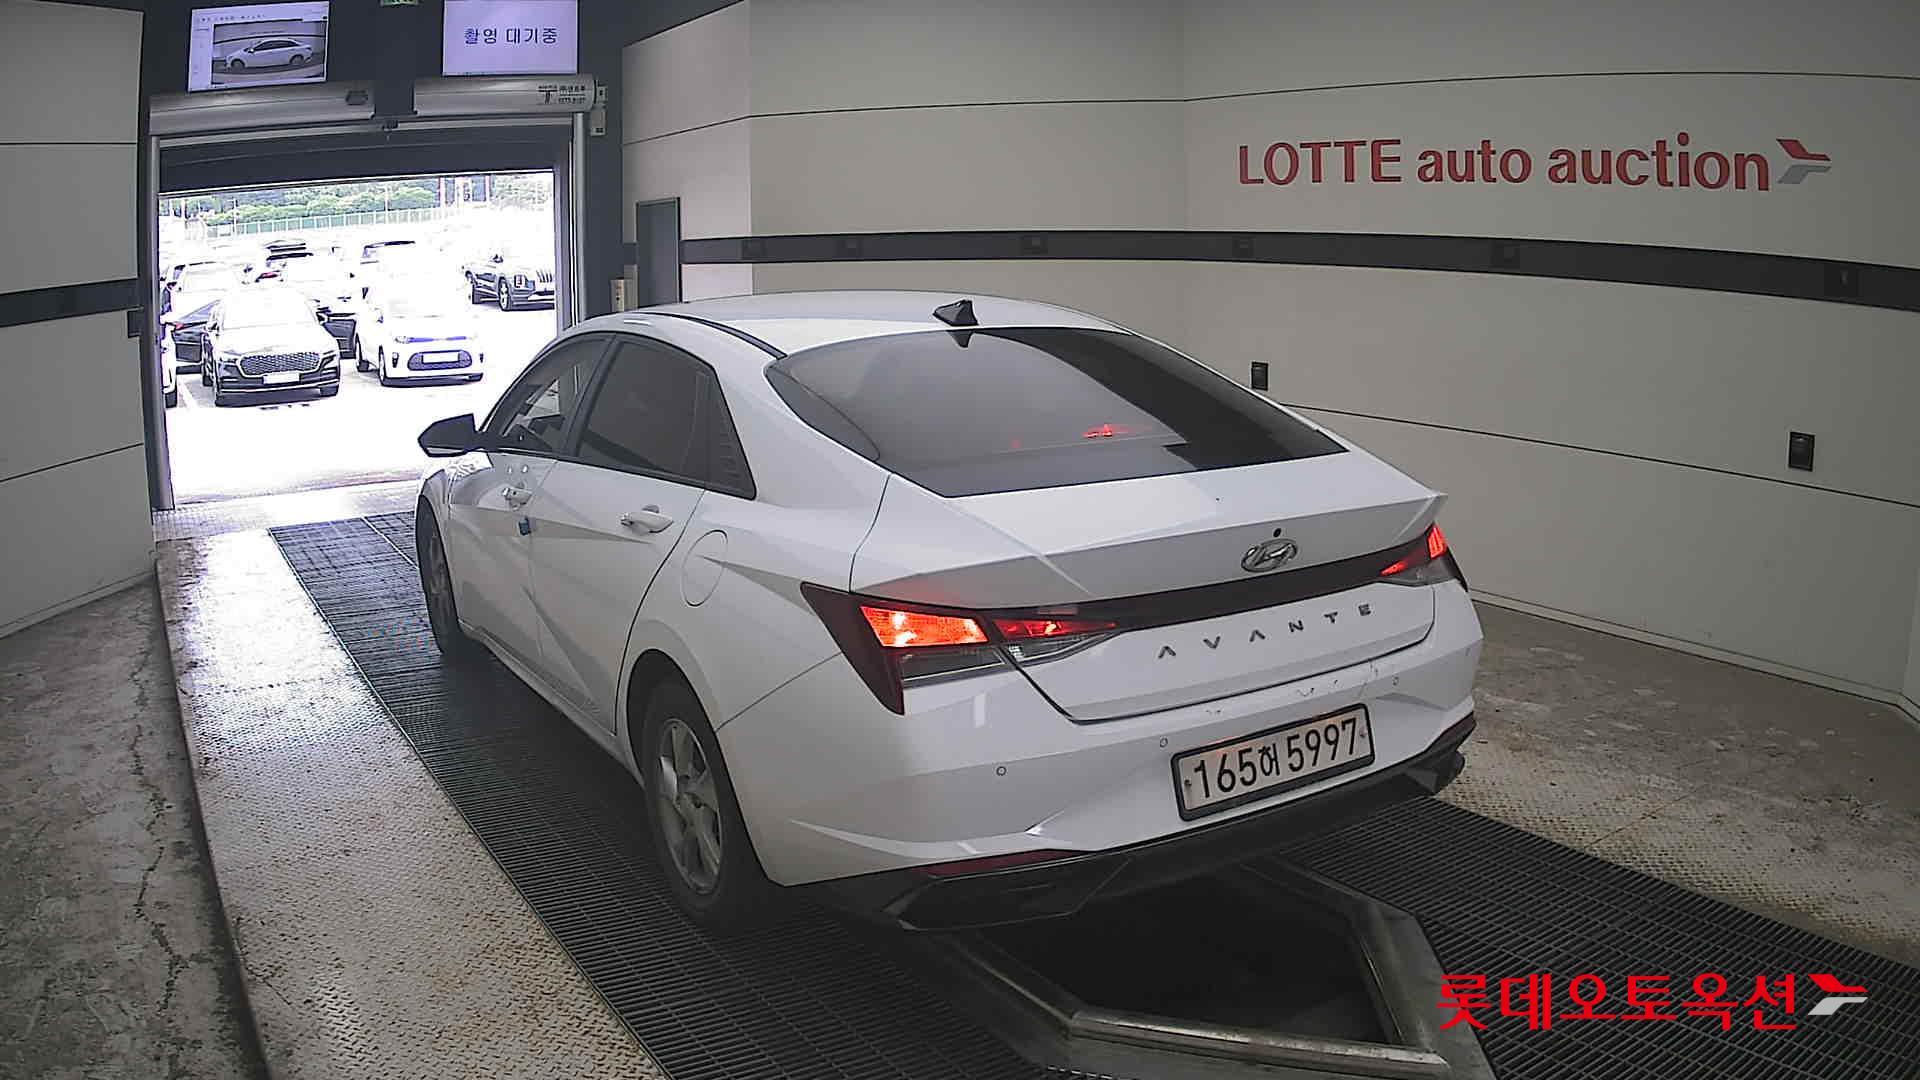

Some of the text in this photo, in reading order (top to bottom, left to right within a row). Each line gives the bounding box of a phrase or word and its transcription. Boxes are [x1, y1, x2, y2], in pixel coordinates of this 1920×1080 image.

[506, 27, 558, 45] 대기중
[1238, 131, 1771, 191] LOTTE auto auction
[1157, 603, 1372, 660] AVANTE
